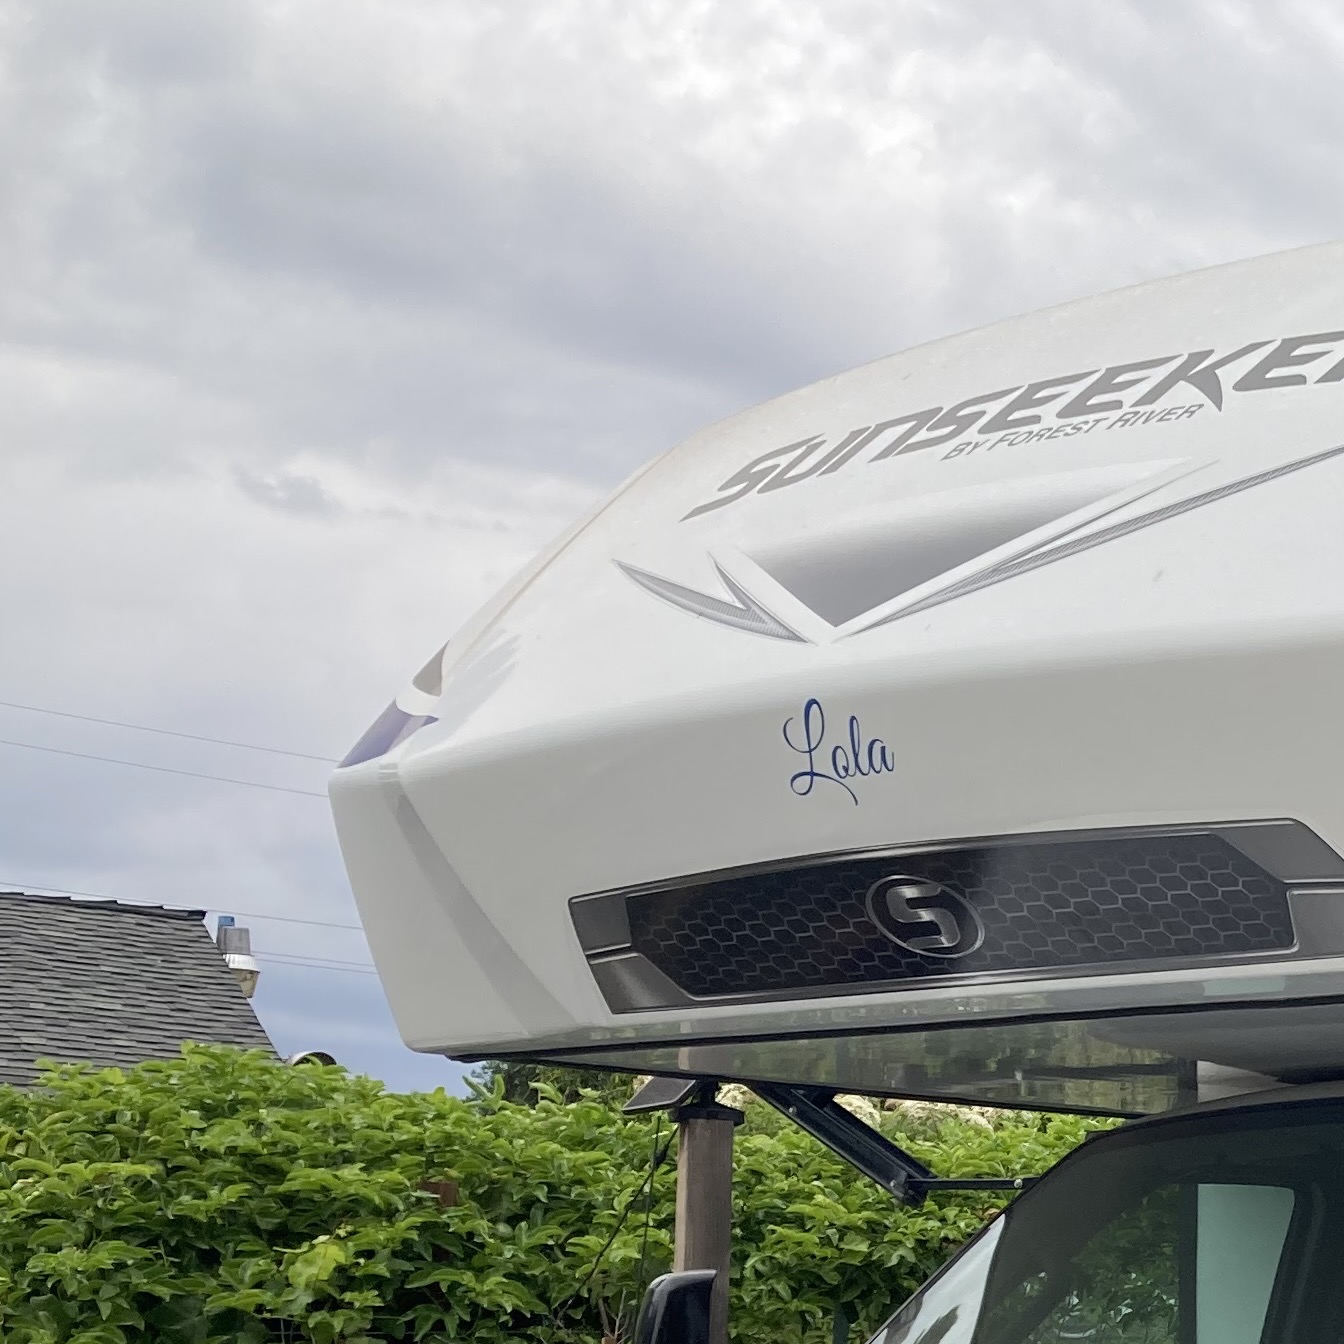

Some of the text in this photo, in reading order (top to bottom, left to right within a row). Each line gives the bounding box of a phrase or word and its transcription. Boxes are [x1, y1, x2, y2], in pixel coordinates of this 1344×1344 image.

[940, 404, 1204, 461] BY FOREST RIVER
[783, 698, 894, 805] Lola
